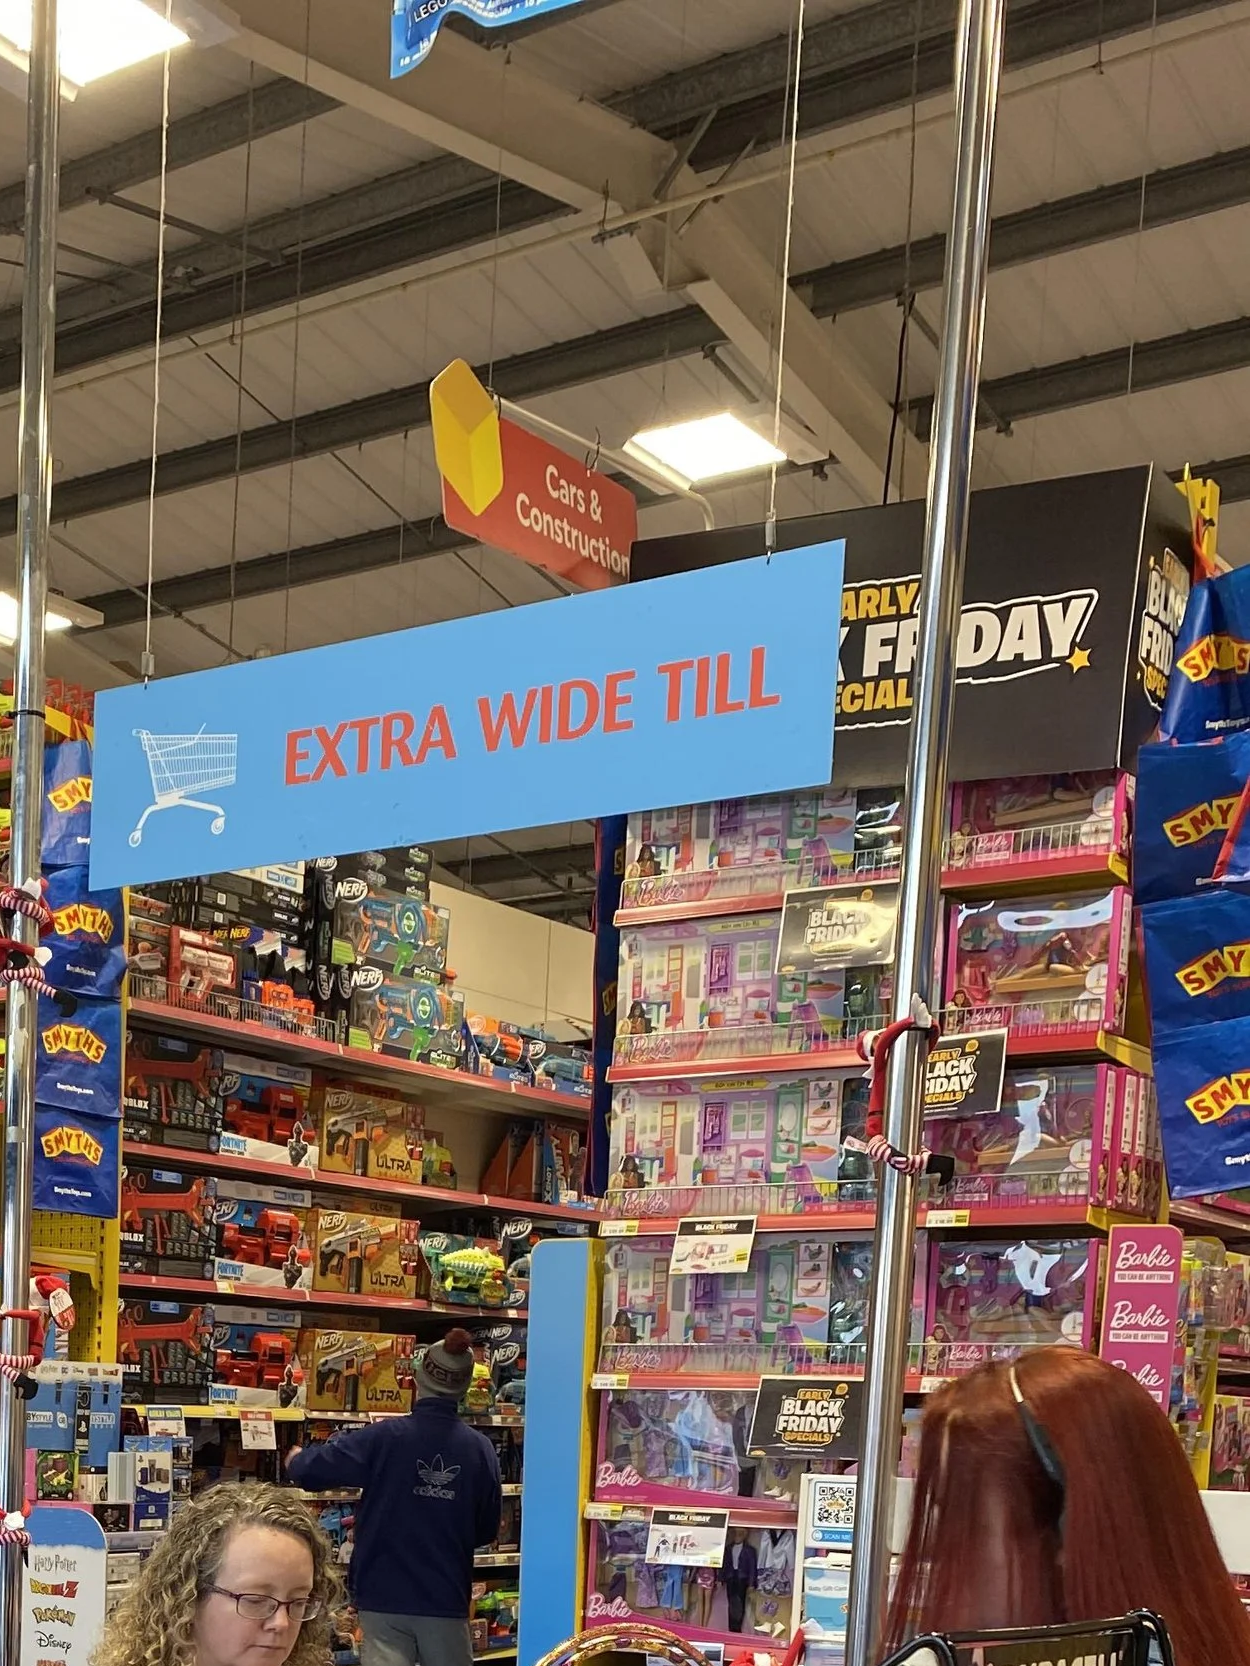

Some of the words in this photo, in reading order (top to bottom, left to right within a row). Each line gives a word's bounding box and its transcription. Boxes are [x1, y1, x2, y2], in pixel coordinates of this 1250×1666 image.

[545, 464, 585, 514] Cars
[590, 489, 602, 524] &
[516, 493, 630, 577] Construction
[842, 583, 920, 621] ARLY
[862, 596, 1091, 678] FRDAY
[1141, 618, 1173, 676] FRID
[284, 702, 458, 787] EXTRA
[475, 669, 636, 753] WIDE
[656, 646, 782, 723] TILL
[335, 880, 367, 898] NERF
[54, 906, 112, 939] SMYTHS
[351, 969, 382, 985] NERF
[45, 1029, 103, 1060] SMYTHS
[44, 1132, 101, 1164] SMYTHS
[377, 1156, 412, 1174] ULTRA
[623, 1191, 670, 1217] Barbie
[319, 1214, 347, 1229] NERF
[502, 1221, 532, 1238] NERF
[420, 1236, 447, 1250] NERF
[1116, 1241, 1175, 1268] Barbie
[371, 1272, 406, 1289] ULTRA
[1110, 1301, 1169, 1327] Barbie
[315, 1335, 342, 1349] NERF
[494, 1344, 519, 1363] NERF
[616, 1345, 661, 1368] Barbie
[366, 1387, 402, 1402] ULTRA
[798, 1389, 832, 1400] EARLY
[782, 1400, 844, 1417] BLACK
[778, 1417, 842, 1434] FRIDAY
[782, 1433, 833, 1442] SPECIALS
[597, 1462, 642, 1488] Barbie
[34, 1555, 54, 1573] Harry
[55, 1556, 77, 1572] Potter
[587, 1592, 632, 1618] Barbie
